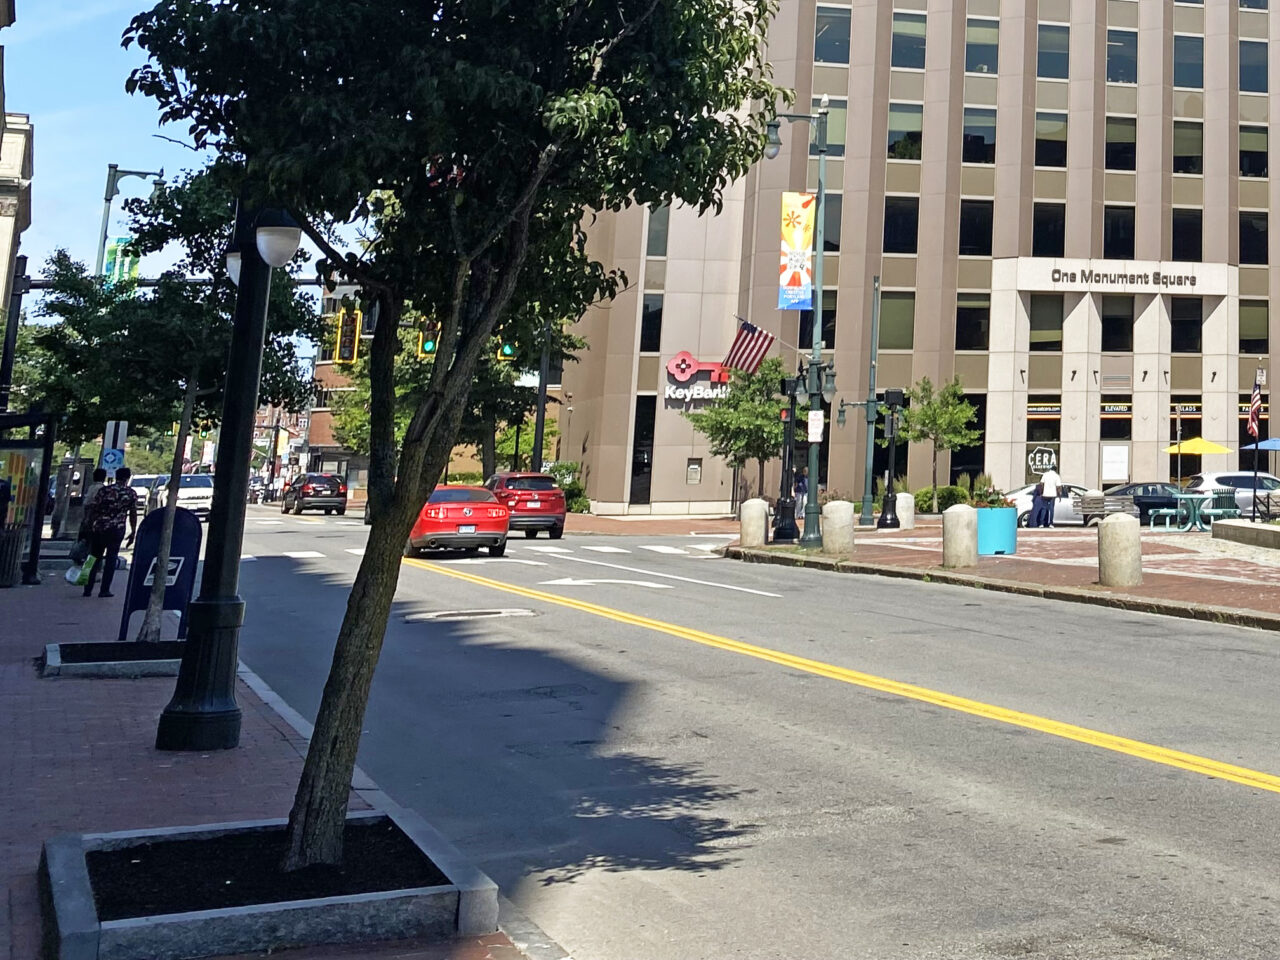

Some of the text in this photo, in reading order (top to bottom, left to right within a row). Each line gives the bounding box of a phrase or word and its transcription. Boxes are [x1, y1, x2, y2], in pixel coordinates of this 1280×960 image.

[1051, 268, 1197, 288] One Monument Square
[1028, 452, 1057, 465] CERA
